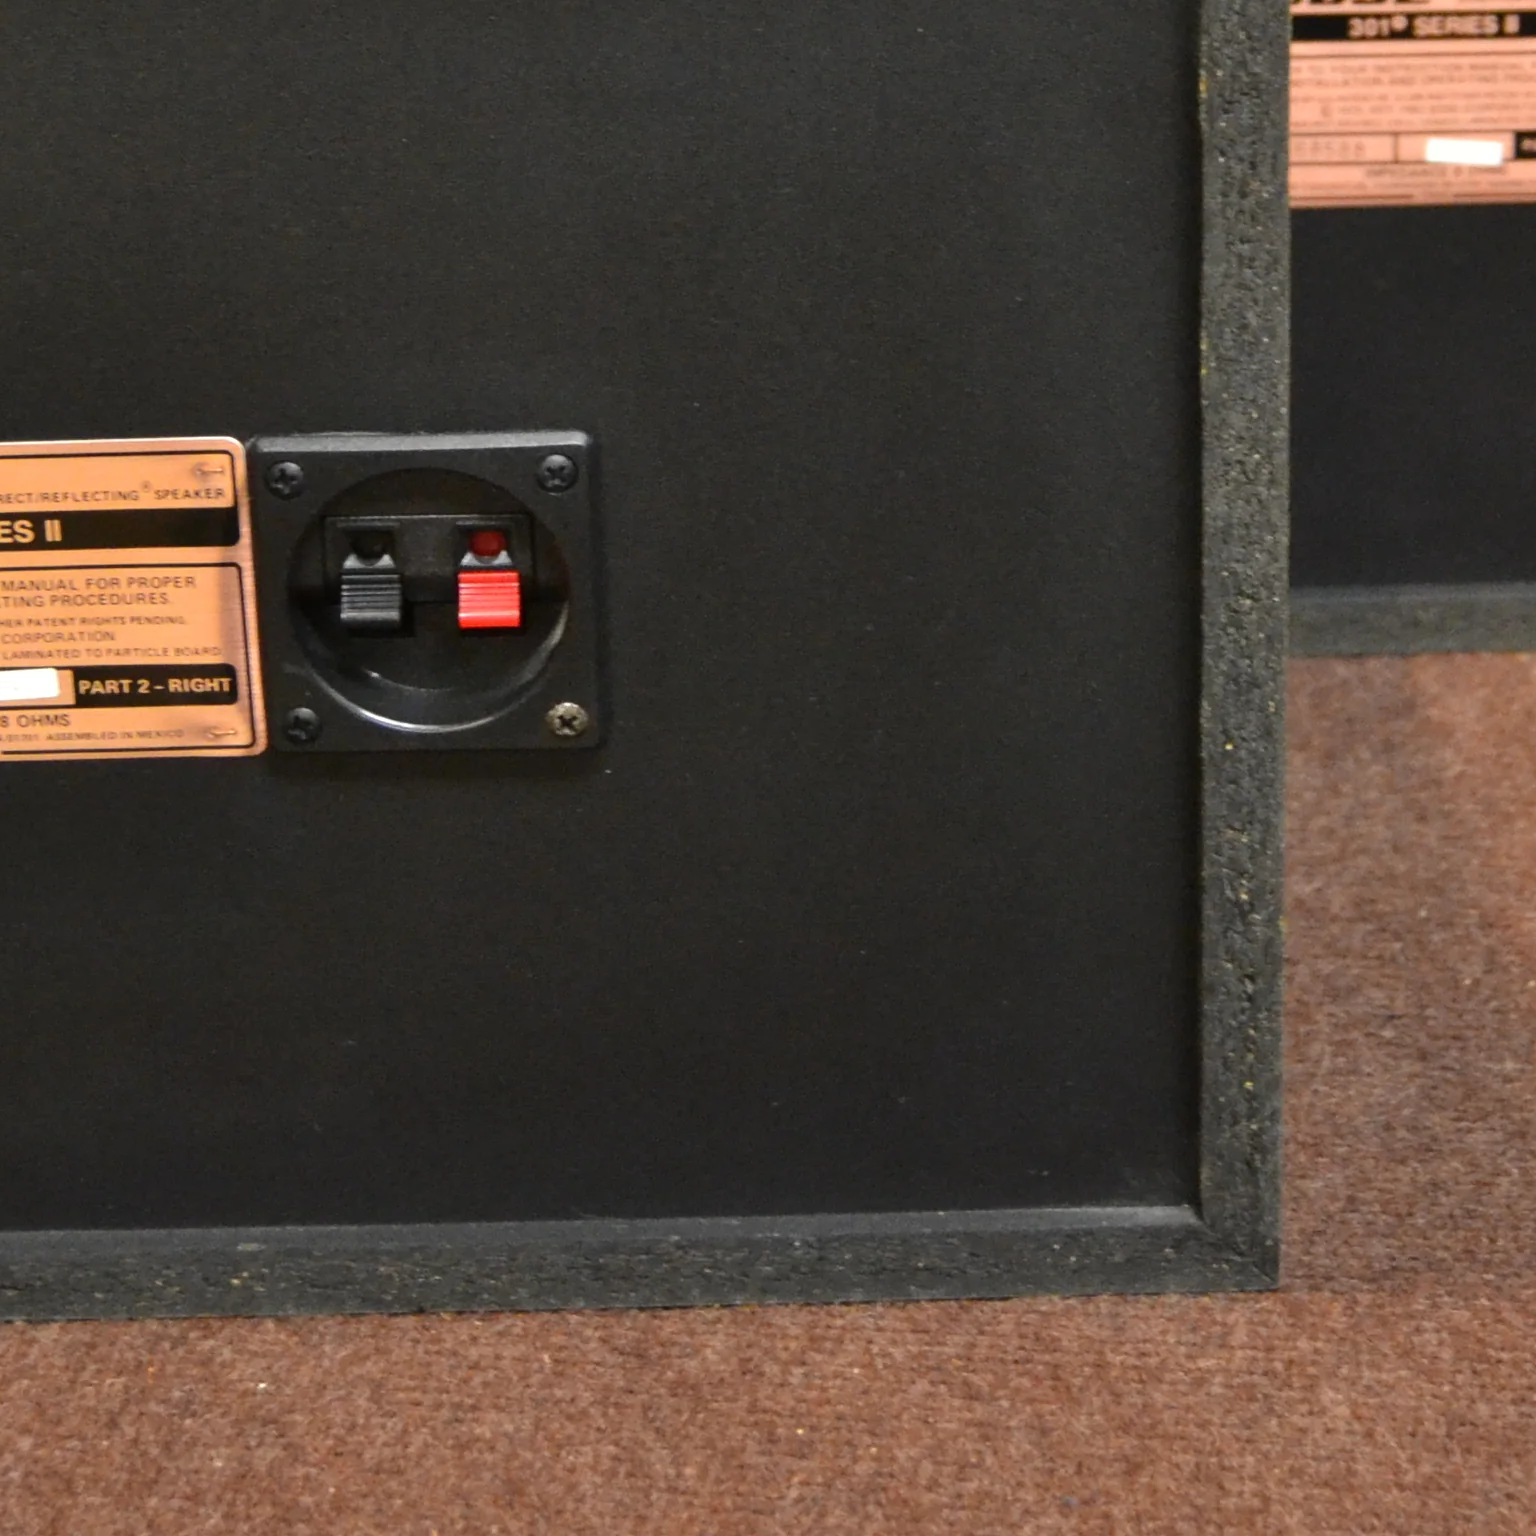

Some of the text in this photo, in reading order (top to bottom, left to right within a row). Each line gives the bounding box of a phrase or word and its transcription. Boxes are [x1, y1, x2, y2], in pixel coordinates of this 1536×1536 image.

[1413, 13, 1500, 38] SERIES
[154, 487, 225, 501] SPEAKER
[43, 518, 63, 543] II
[1, 577, 79, 593] MANUAL
[85, 576, 122, 591] FOR
[126, 575, 197, 589] PROPER
[27, 616, 77, 627] PATENT
[79, 615, 127, 627] RIGHTS
[0, 630, 117, 645] CORPORATION
[1, 648, 82, 661] LAMINATED
[85, 647, 104, 659] TO
[105, 646, 170, 658] PARTICLE
[77, 679, 134, 695] PART
[137, 678, 152, 694] 2
[167, 676, 233, 693] RIGHT
[16, 712, 72, 728] OHMS
[46, 730, 116, 741] ASSEMBLED
[120, 729, 134, 740] IN
[136, 728, 185, 740] MEXICO
